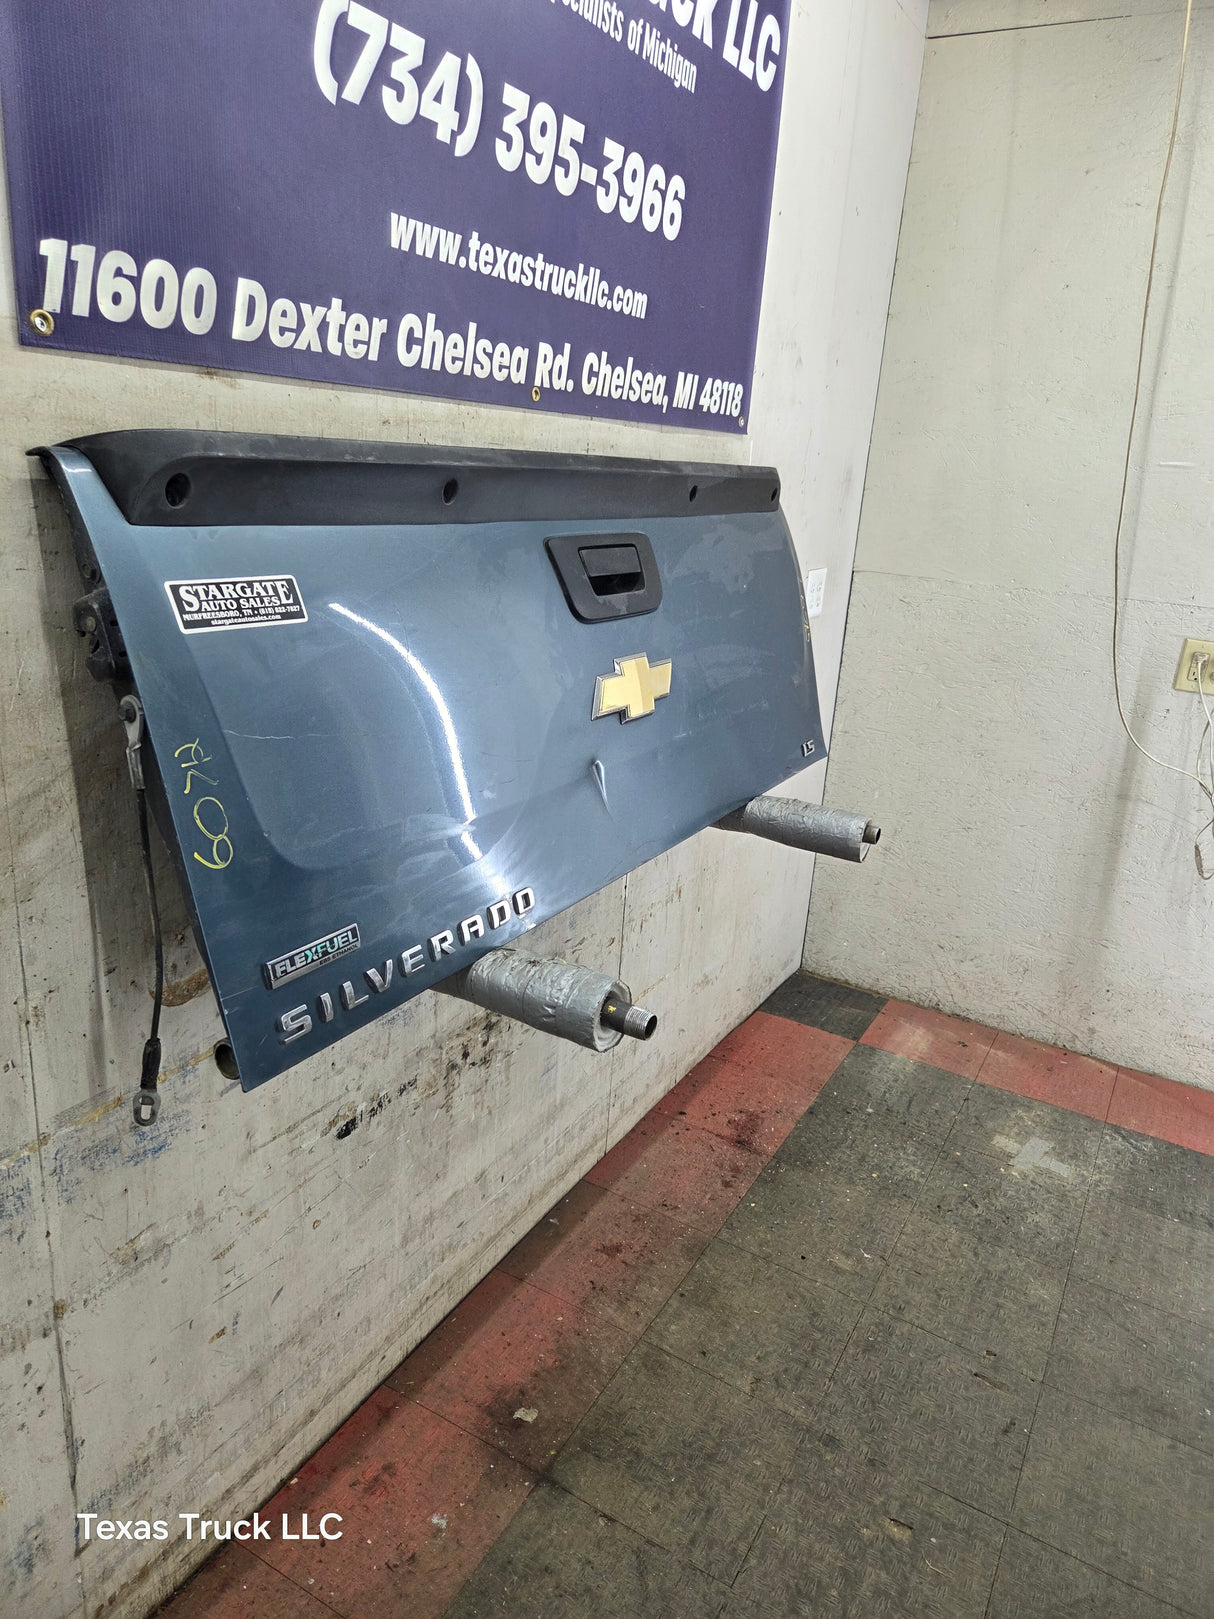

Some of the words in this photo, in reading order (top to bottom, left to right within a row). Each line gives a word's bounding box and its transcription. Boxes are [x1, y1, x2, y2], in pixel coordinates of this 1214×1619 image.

[627, 18, 645, 55] of
[642, 22, 697, 93] Michigan
[722, 0, 781, 92] LLC
[313, 0, 484, 157] (734)
[495, 82, 686, 241] 395-3966
[390, 211, 648, 319] www.texastruckllc.com
[39, 237, 218, 335] 11600
[231, 276, 388, 361] Dexter
[396, 312, 530, 385] Chelsea
[533, 341, 575, 392] Rd.
[581, 350, 669, 413] Chelsea,
[672, 371, 699, 410] MI
[698, 377, 744, 417] 48118
[178, 580, 294, 612] STARGATE
[201, 599, 238, 612] AUTO
[239, 596, 280, 609] SALES
[211, 614, 282, 626] stargateautosales.com
[242, 608, 254, 616] TN
[274, 930, 358, 978] FLEXFUEL
[278, 886, 536, 1045] SILVERADO
